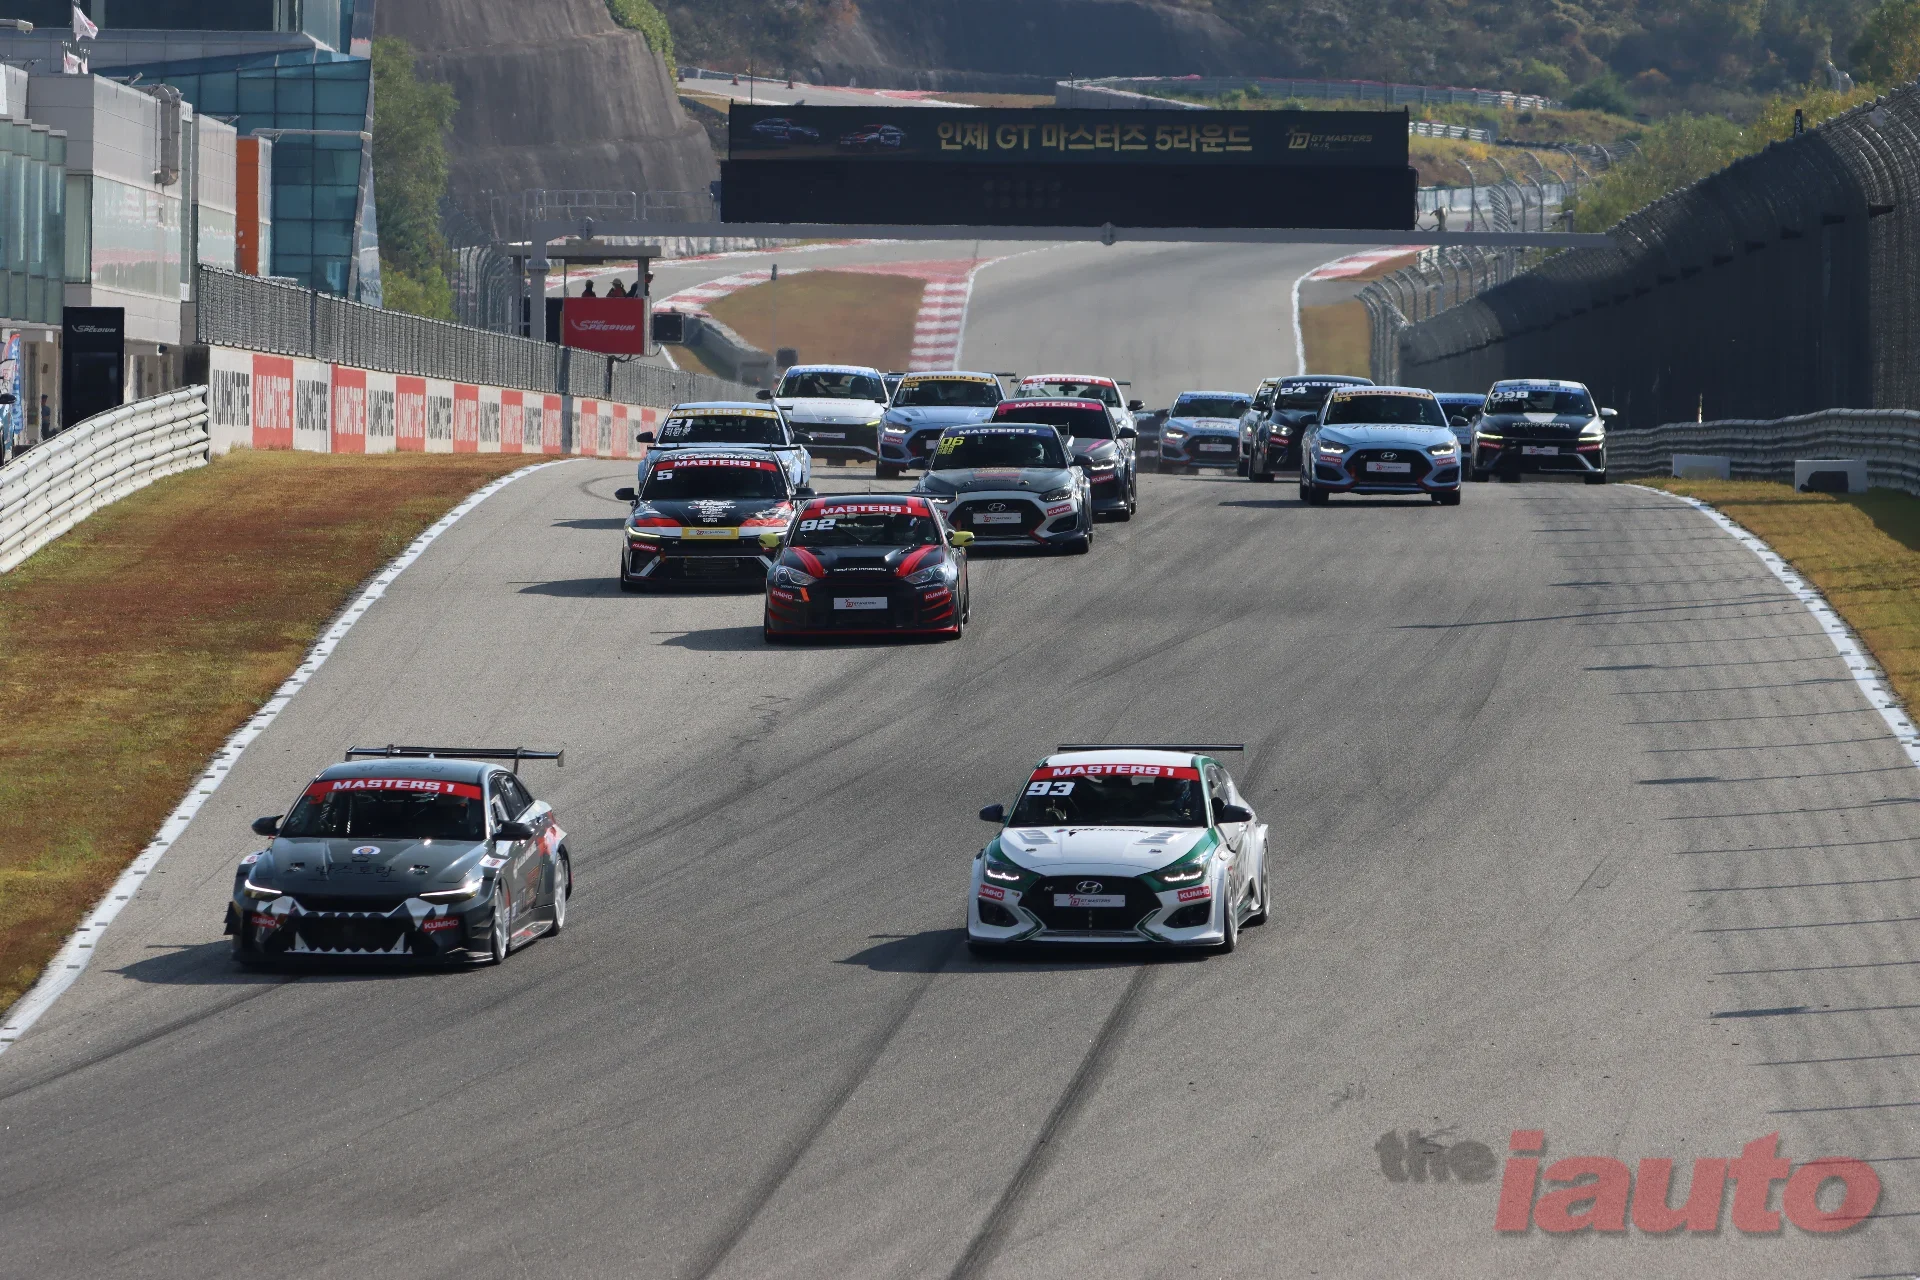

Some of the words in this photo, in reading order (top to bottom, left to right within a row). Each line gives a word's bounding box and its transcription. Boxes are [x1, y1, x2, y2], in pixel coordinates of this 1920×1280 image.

[937, 123, 988, 150] 인제
[996, 124, 1037, 150] GT
[1041, 123, 1148, 151] 마스터즈
[1155, 123, 1253, 152] 5라운드
[1325, 134, 1373, 142] MASTERS
[1281, 387, 1307, 395] 24
[672, 409, 742, 417] MASTERS
[666, 418, 693, 428] 21
[941, 436, 965, 446] 06
[656, 470, 673, 480] 5
[820, 505, 901, 515] MASTERS
[905, 506, 912, 514] 1
[1048, 505, 1072, 516] KUMHO
[800, 519, 836, 531] 92
[632, 543, 657, 551] KUMHO
[1052, 765, 1160, 776] MASTERS
[1166, 768, 1175, 776] 1
[332, 780, 441, 791] MASTERS
[446, 784, 455, 792] 1
[1026, 781, 1075, 796] 93
[1179, 888, 1211, 900] KUMHO
[424, 919, 459, 930] KUMHO
